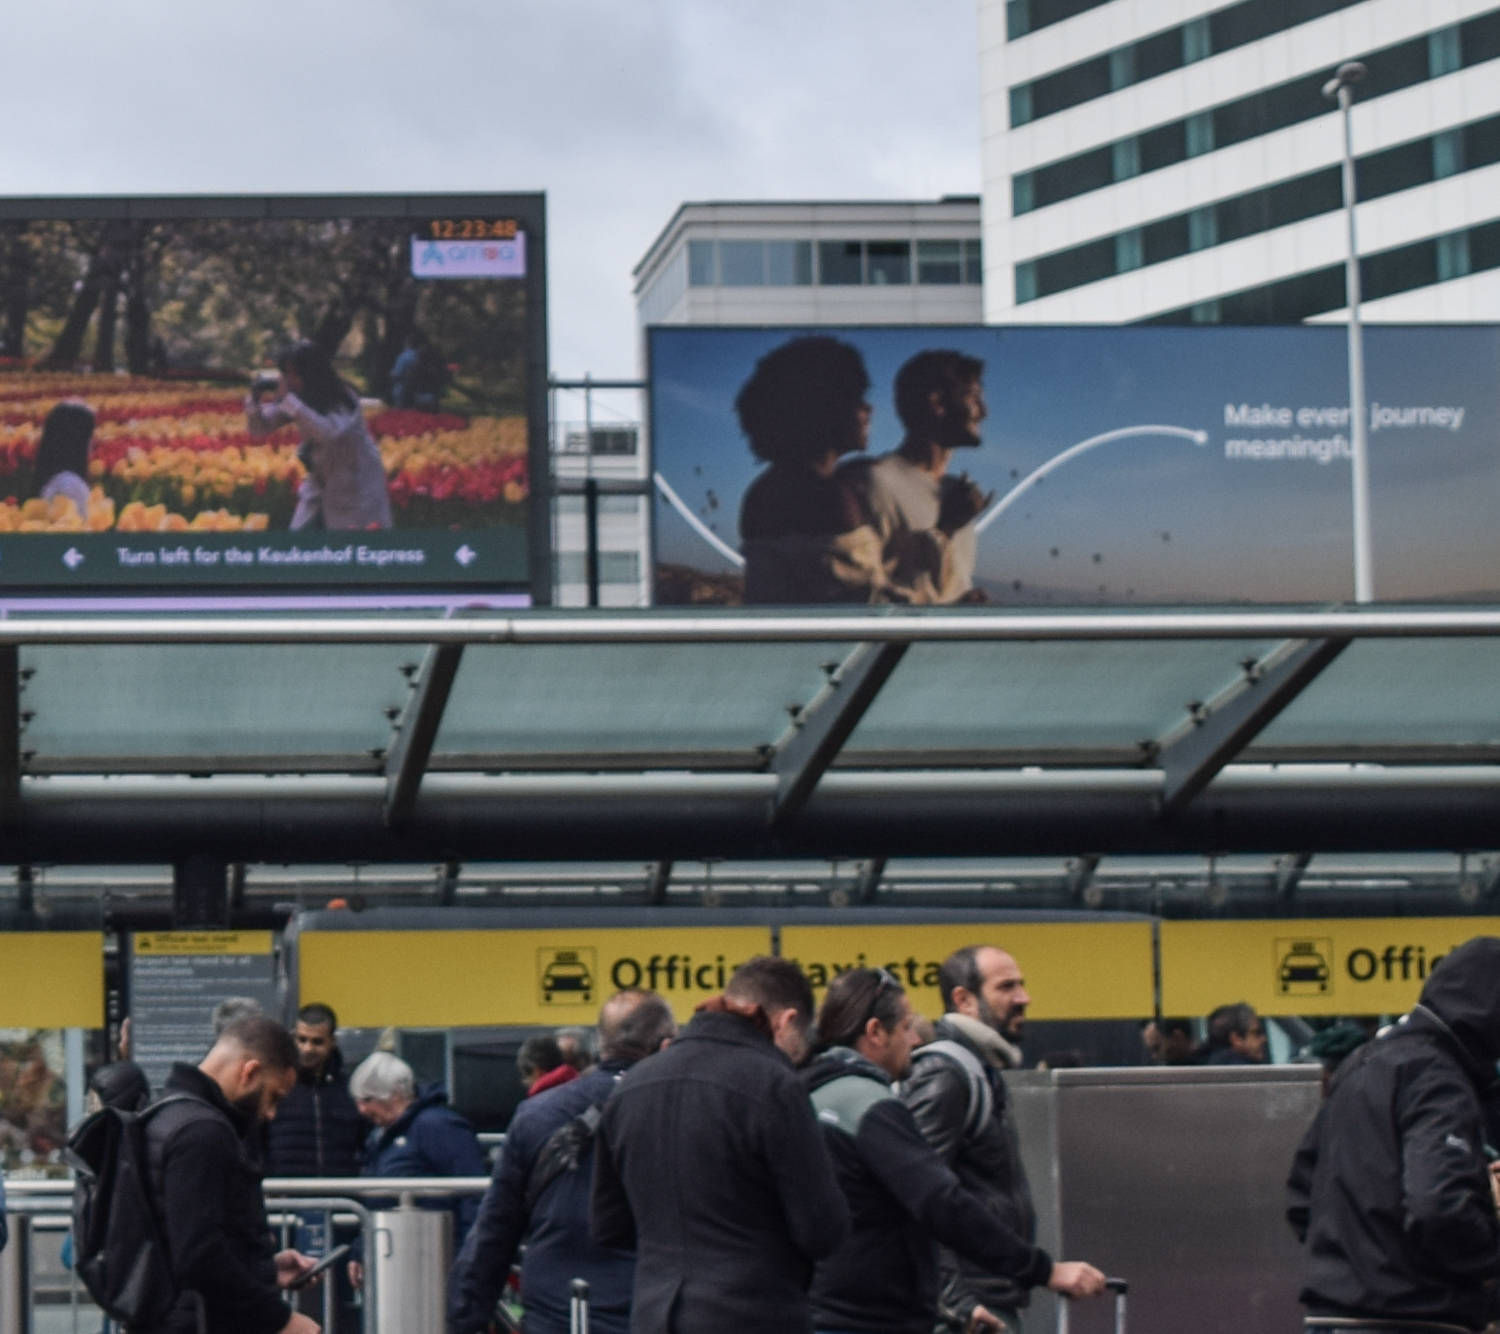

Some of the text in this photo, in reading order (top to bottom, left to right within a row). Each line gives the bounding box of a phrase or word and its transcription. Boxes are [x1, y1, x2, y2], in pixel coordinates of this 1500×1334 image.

[1224, 403, 1465, 431] Make ever journey
[1224, 434, 1354, 464] meaningfu
[117, 546, 424, 567] Turn left for the Keukenhof Express
[611, 954, 740, 990] Offici
